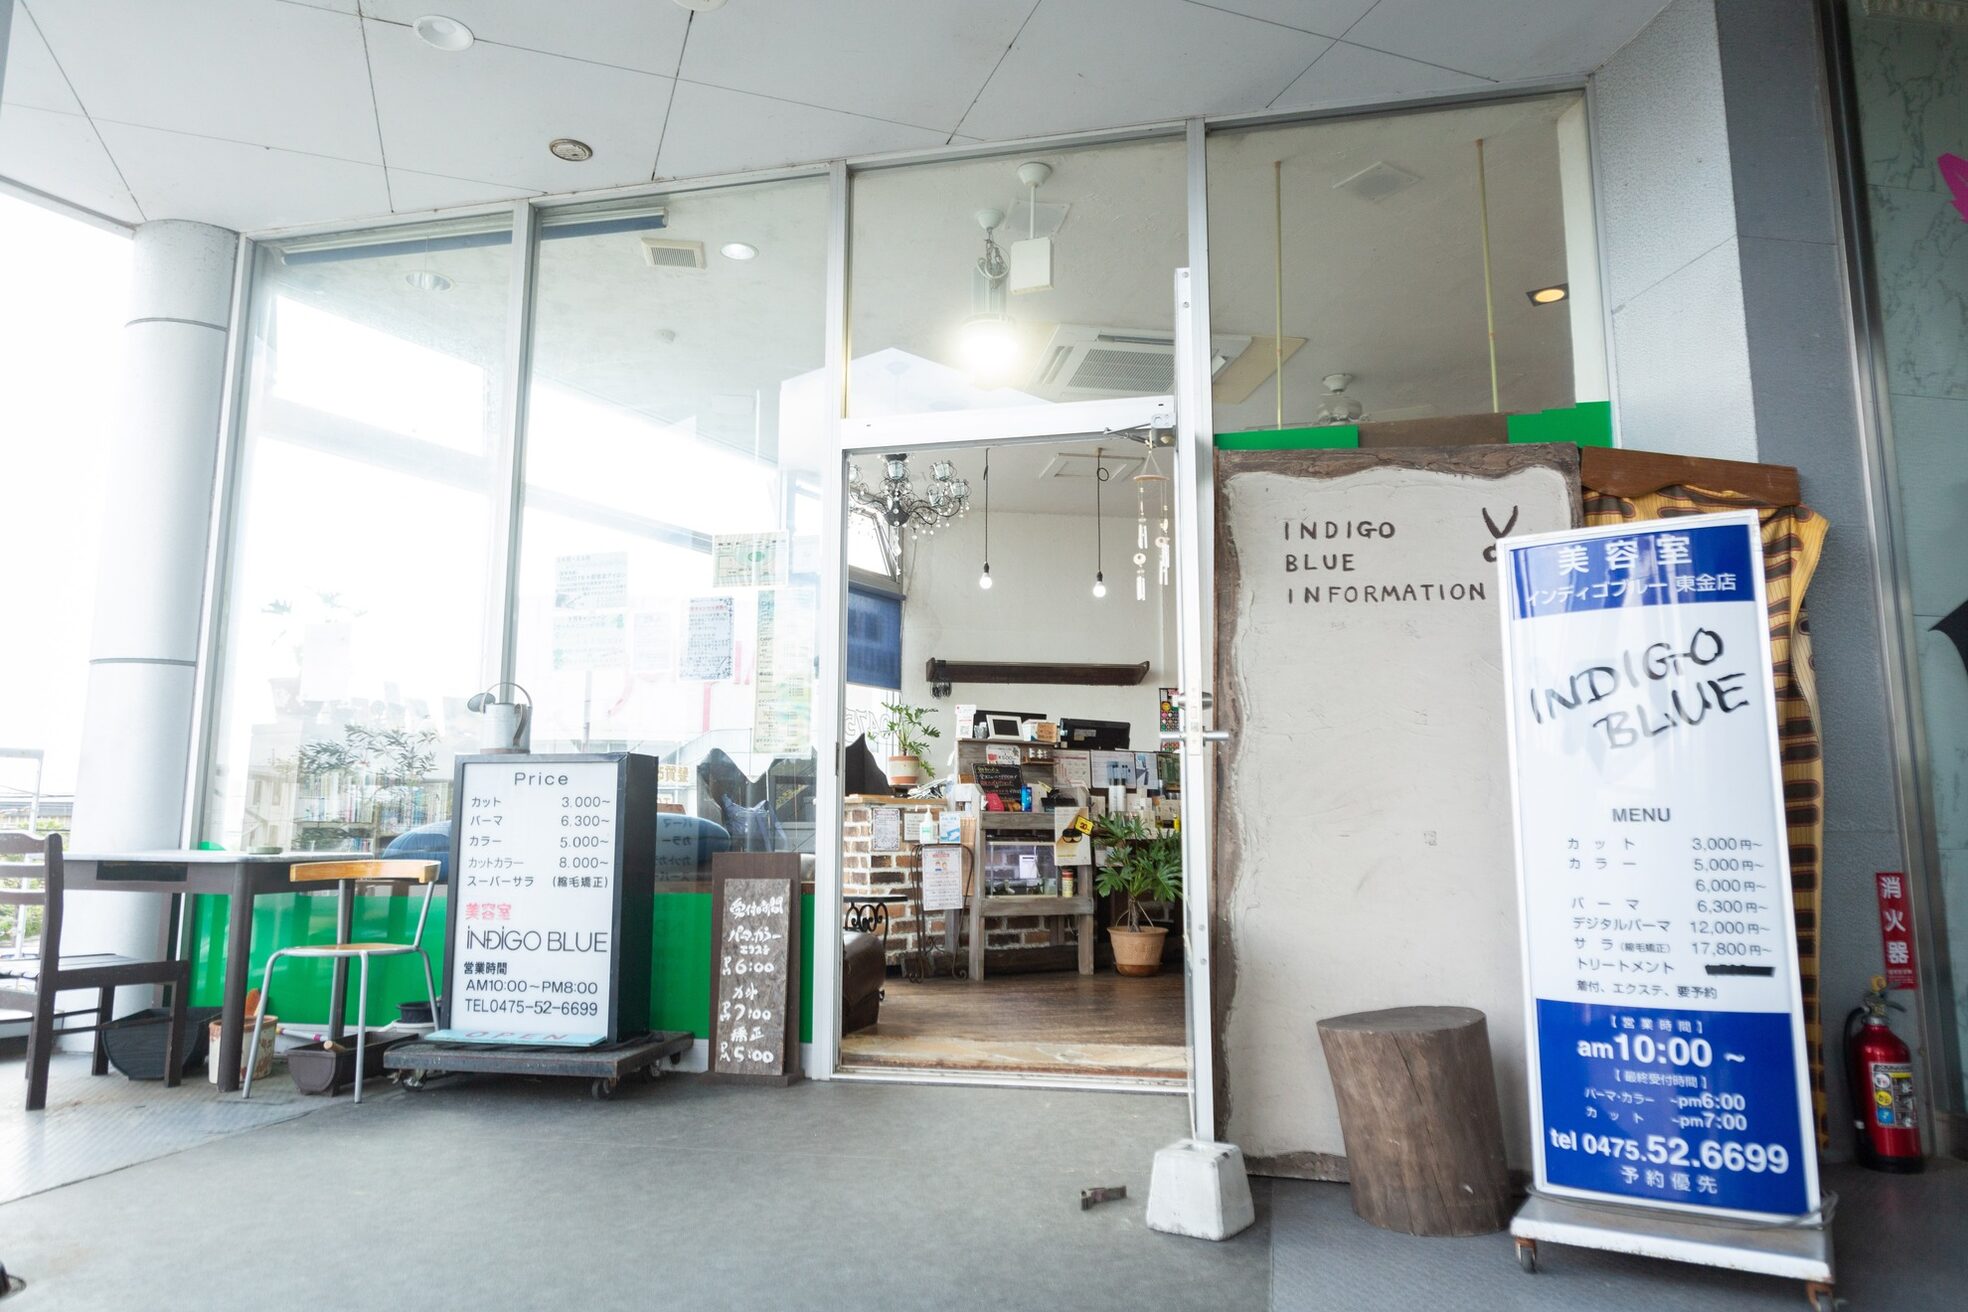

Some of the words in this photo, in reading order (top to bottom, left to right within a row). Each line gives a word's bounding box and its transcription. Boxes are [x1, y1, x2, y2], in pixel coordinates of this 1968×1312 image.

[1284, 520, 1396, 541] INDIGO
[1285, 553, 1356, 573] BLUE
[1557, 533, 1693, 576] 美容室
[1676, 573, 1737, 594] 東金店
[1288, 582, 1486, 604] INFORMATION
[1529, 627, 1724, 725] INDIGO
[1592, 672, 1749, 750] BLUE
[514, 771, 569, 787] Price
[470, 796, 502, 809] カット
[1612, 807, 1671, 823] MENU
[469, 836, 502, 848] カラー
[1567, 837, 1636, 851] カット
[467, 857, 524, 869] カットカラー
[1568, 857, 1637, 870] カラー
[465, 902, 512, 921] 美容室
[1880, 876, 1910, 965] 消火器
[547, 931, 608, 953] BLUE
[1574, 937, 1614, 951] サラ
[463, 961, 508, 975] 営業時間
[735, 958, 775, 975] 6:00
[1576, 957, 1675, 974] トリートメント
[733, 1003, 772, 1021] 7:00
[734, 1047, 774, 1064] 5:00
[1577, 1034, 1713, 1068] am10:00
[1585, 1106, 1644, 1123] カット
[1549, 1127, 1577, 1152] tel
[1582, 1134, 1790, 1175] 0475.52.6699
[1620, 1165, 1718, 1195] 予約優先
